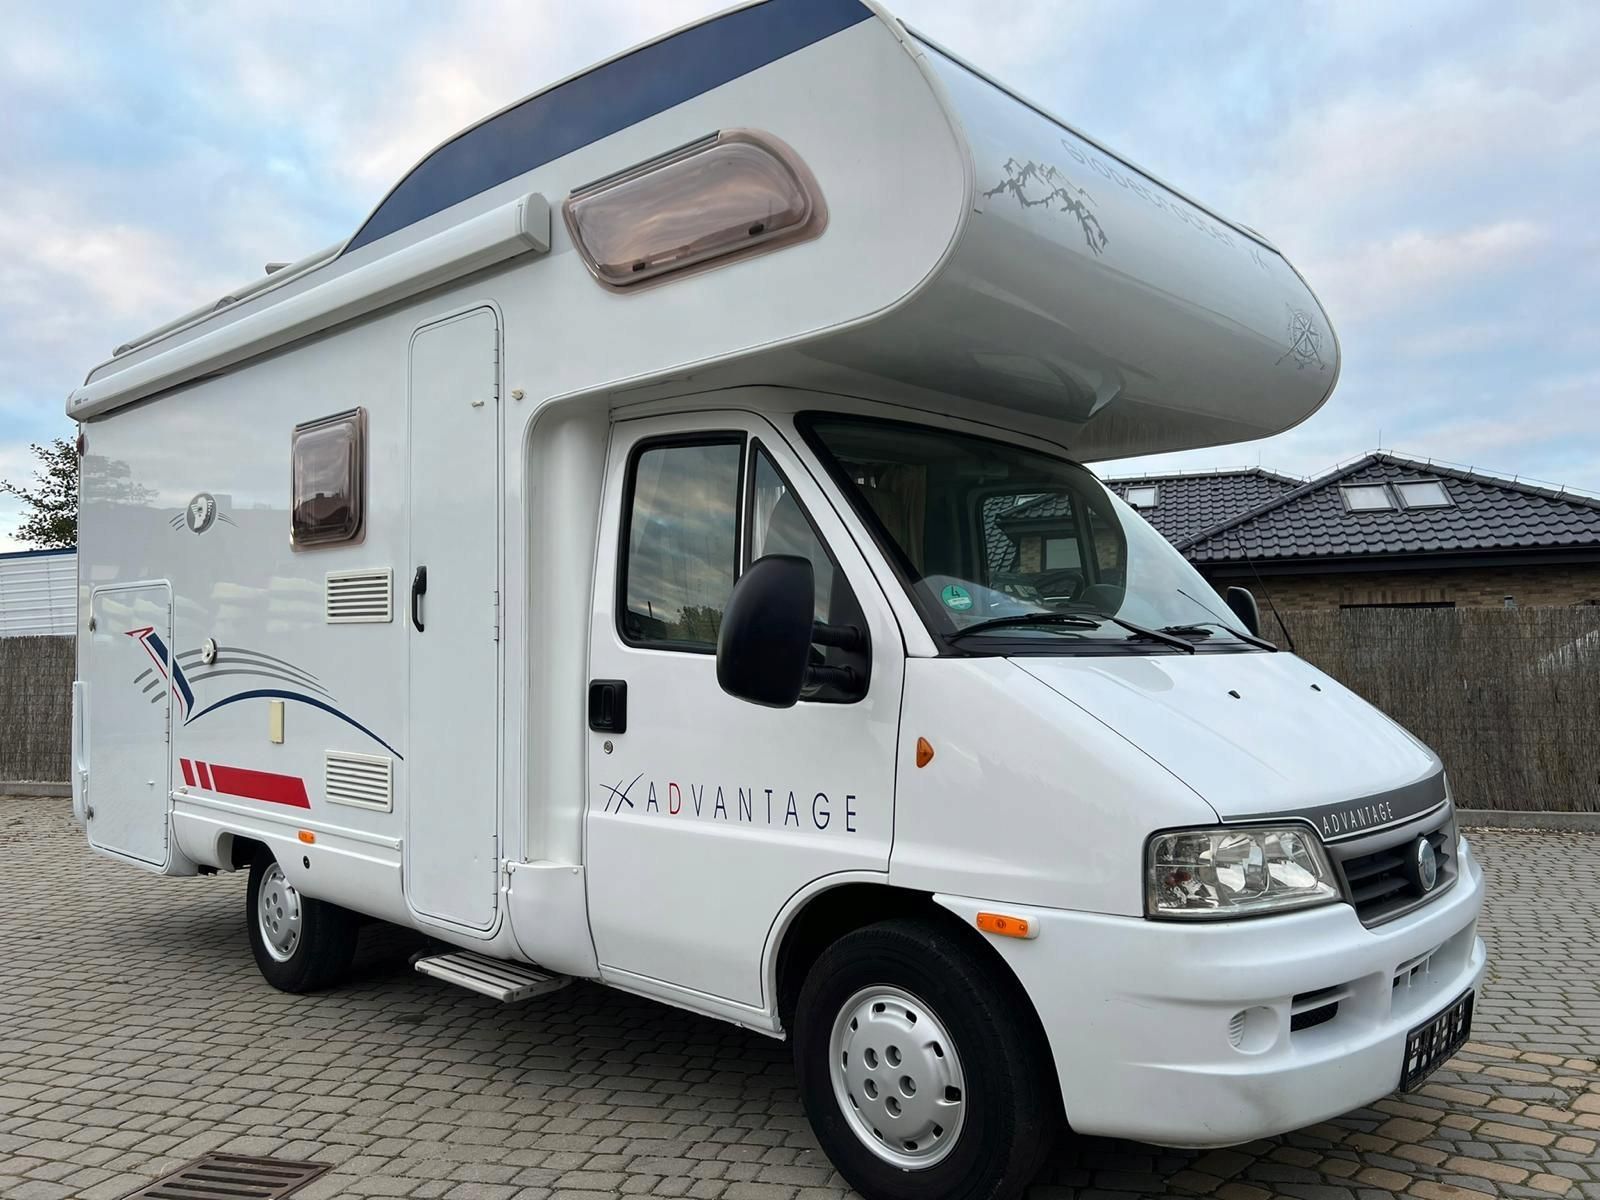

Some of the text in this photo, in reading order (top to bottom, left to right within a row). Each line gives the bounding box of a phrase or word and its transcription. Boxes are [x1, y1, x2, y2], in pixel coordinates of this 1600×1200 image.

[951, 584, 960, 597] 4
[646, 781, 857, 833] ADVANTAGE
[1323, 801, 1394, 834] ADVANTAGE
